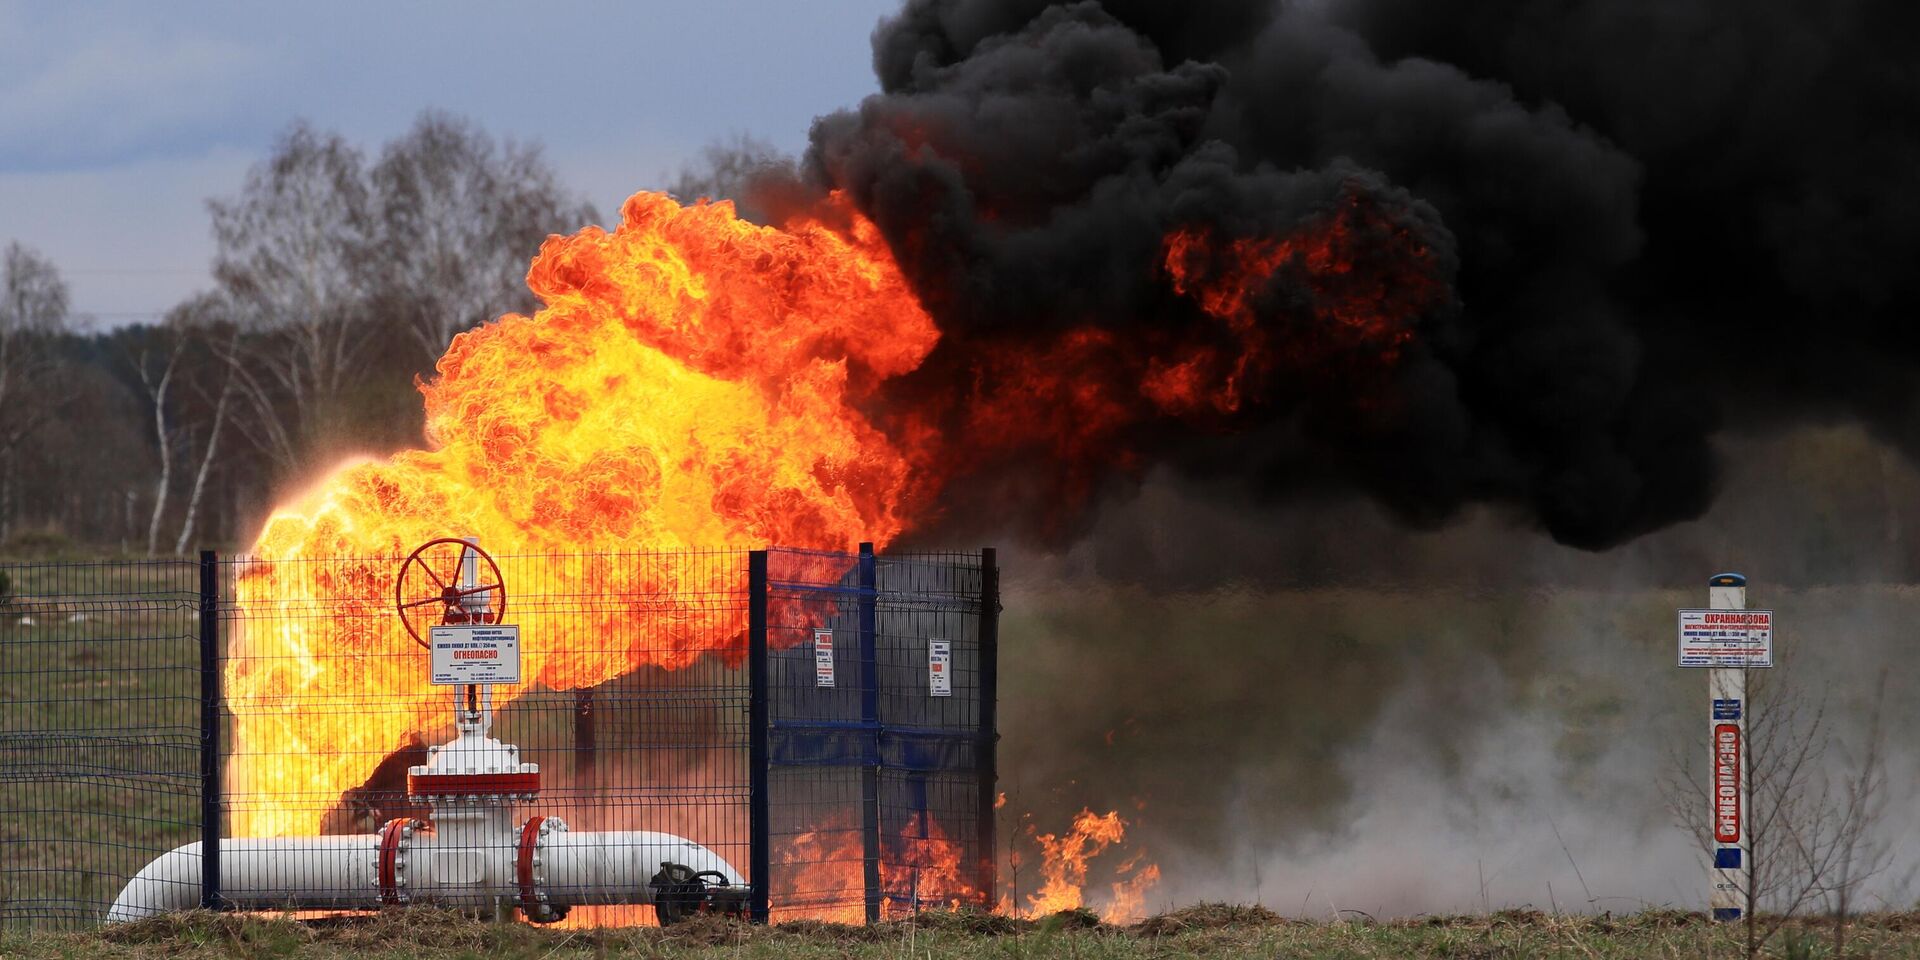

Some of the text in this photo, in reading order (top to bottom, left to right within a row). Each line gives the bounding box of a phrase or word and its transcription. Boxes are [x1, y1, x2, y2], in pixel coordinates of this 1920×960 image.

[1705, 614, 1769, 624] ОХРАННАЯ ЗОНА
[454, 650, 497, 659] ОГНЕОПАСНО
[1719, 732, 1736, 835] ОГНЕОПАСНО
